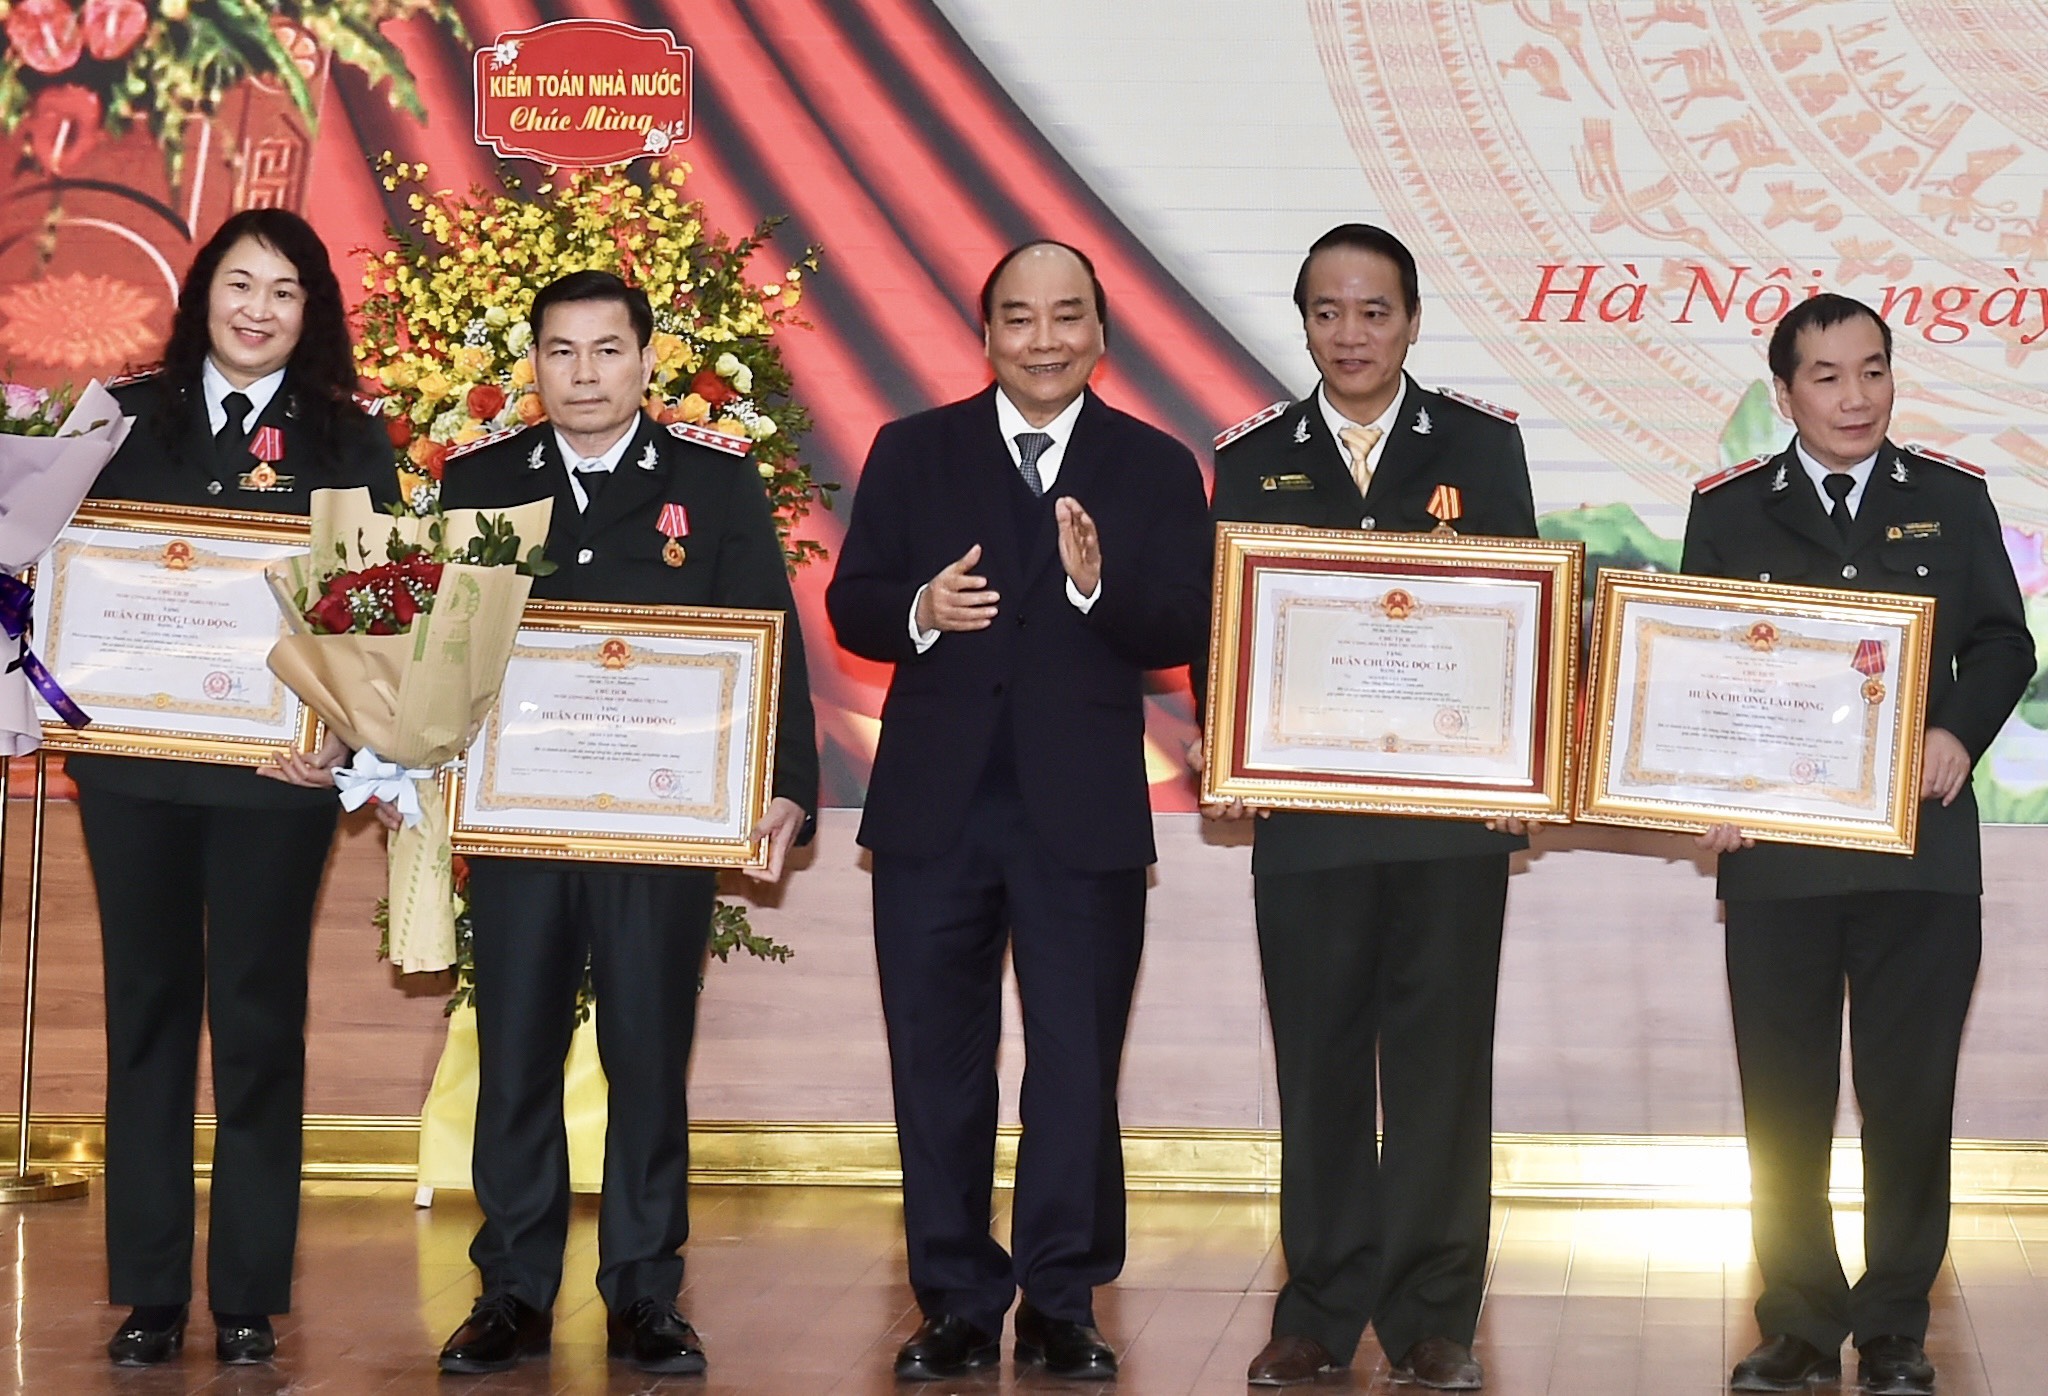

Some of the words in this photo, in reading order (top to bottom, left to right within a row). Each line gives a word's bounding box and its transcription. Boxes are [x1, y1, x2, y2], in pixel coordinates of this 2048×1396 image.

[490, 64, 531, 97] KIỂM
[536, 69, 584, 97] TOÁN
[589, 68, 627, 96] NHÀ
[632, 68, 681, 96] NƯỚC
[510, 105, 571, 132] Chúc
[575, 105, 653, 135] Mừng
[1520, 264, 1648, 323] Hà
